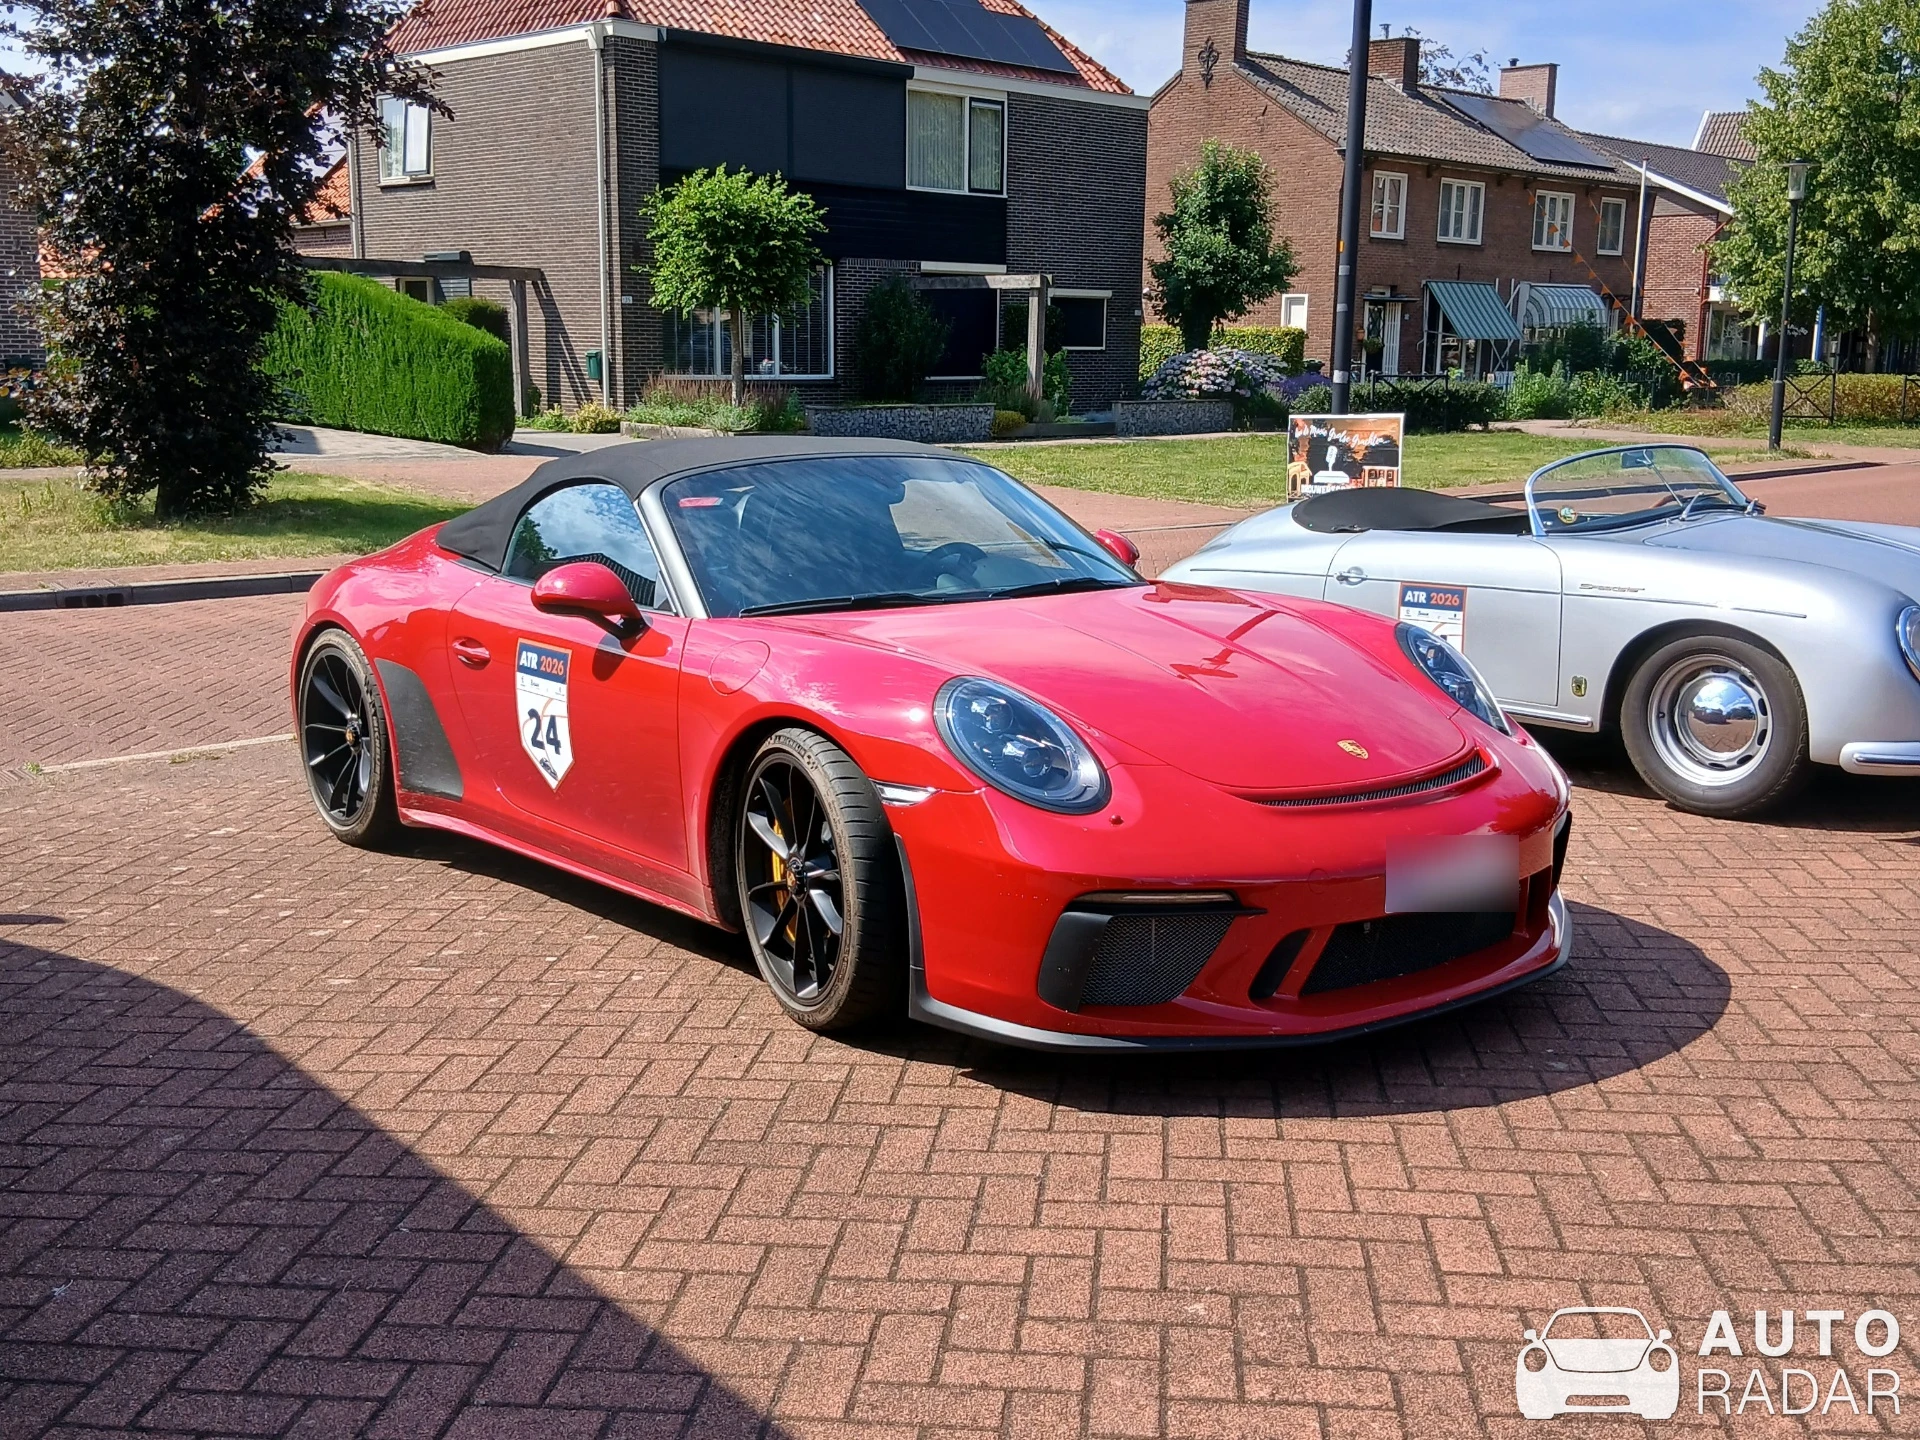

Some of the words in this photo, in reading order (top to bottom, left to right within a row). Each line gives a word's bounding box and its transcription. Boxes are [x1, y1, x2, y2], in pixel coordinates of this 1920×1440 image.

[1404, 590, 1427, 604] ATR
[1430, 592, 1460, 606] 2026
[519, 650, 538, 670] ATR
[540, 655, 564, 676] 2026
[527, 708, 561, 755] 24
